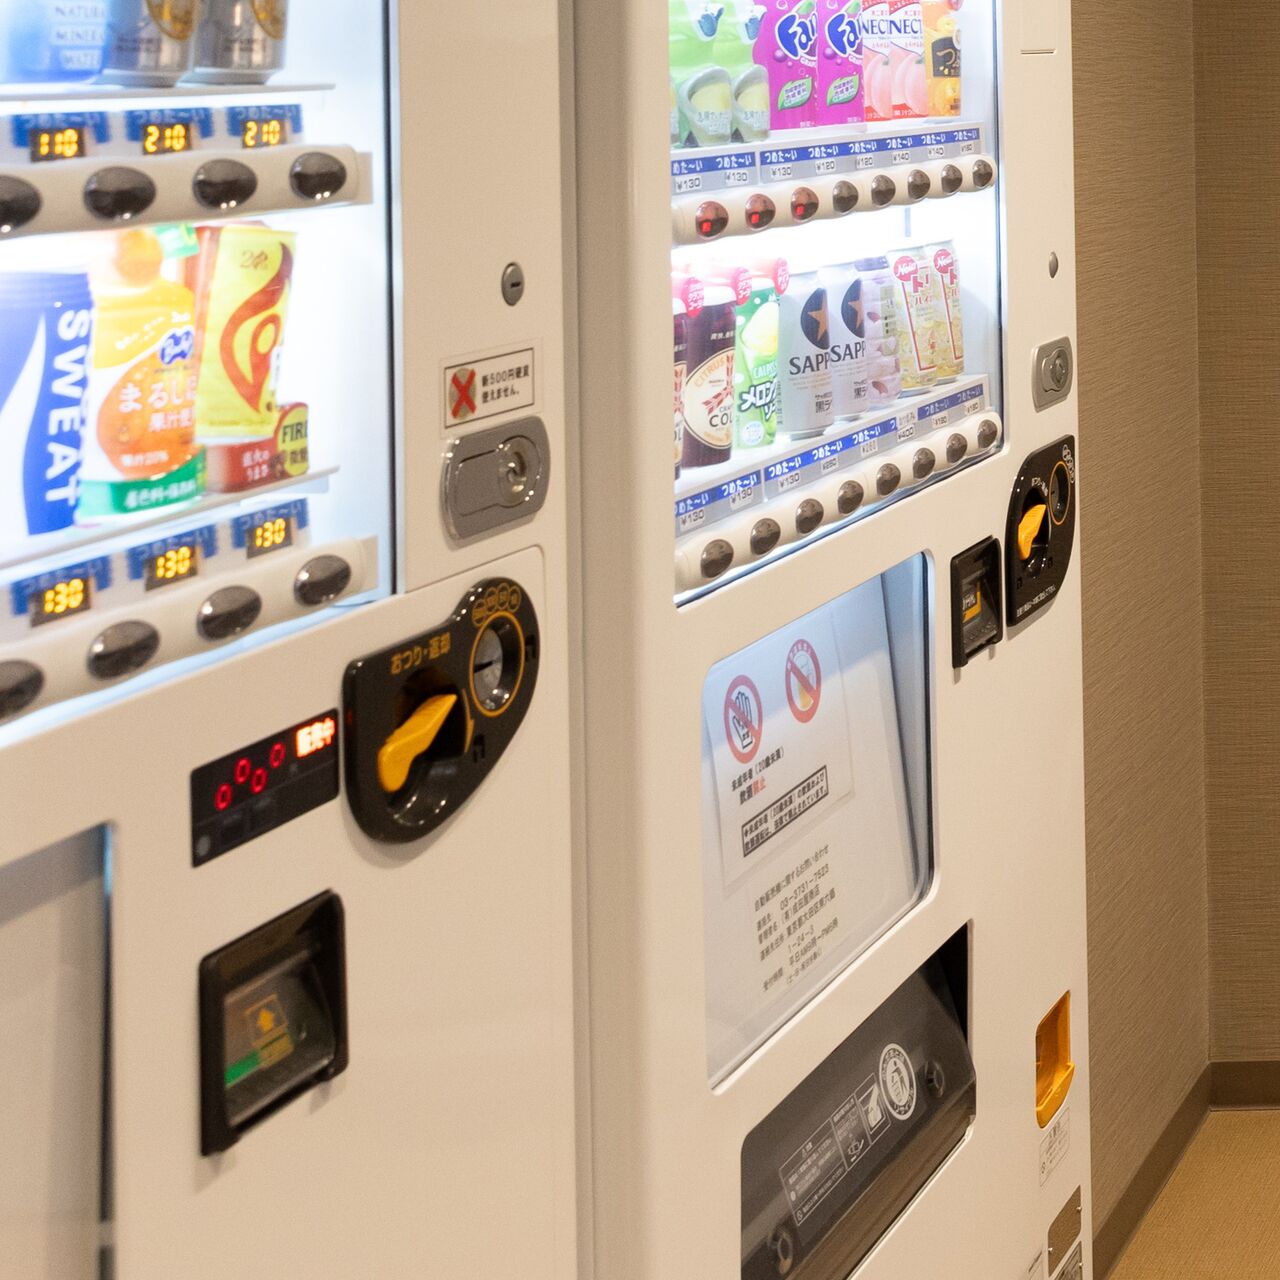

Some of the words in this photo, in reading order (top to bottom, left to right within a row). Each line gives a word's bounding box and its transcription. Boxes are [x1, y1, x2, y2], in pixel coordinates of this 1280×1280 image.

[144, 124, 187, 153] 210
[245, 120, 281, 147] 210
[39, 128, 79, 157] 110
[808, 144, 839, 158] つめた〜い
[849, 143, 877, 154] つめた〜い
[886, 137, 913, 150] つめた〜い
[715, 154, 752, 169] つめた〜い
[765, 149, 798, 163] つめた〜い
[771, 166, 792, 177] ¥130
[676, 176, 701, 191] ¥130
[895, 262, 918, 278] New
[45, 309, 90, 506] SWEAT
[852, 425, 881, 444] つめた〜い
[812, 441, 843, 460] つめた〜い
[769, 456, 802, 477] つめた〜い
[721, 474, 757, 495] つめた〜い
[779, 472, 800, 488] ¥130
[731, 487, 753, 503] ¥130
[680, 510, 705, 526] ¥130
[255, 518, 286, 548] 130
[155, 546, 192, 580] 130
[43, 578, 86, 615] 130
